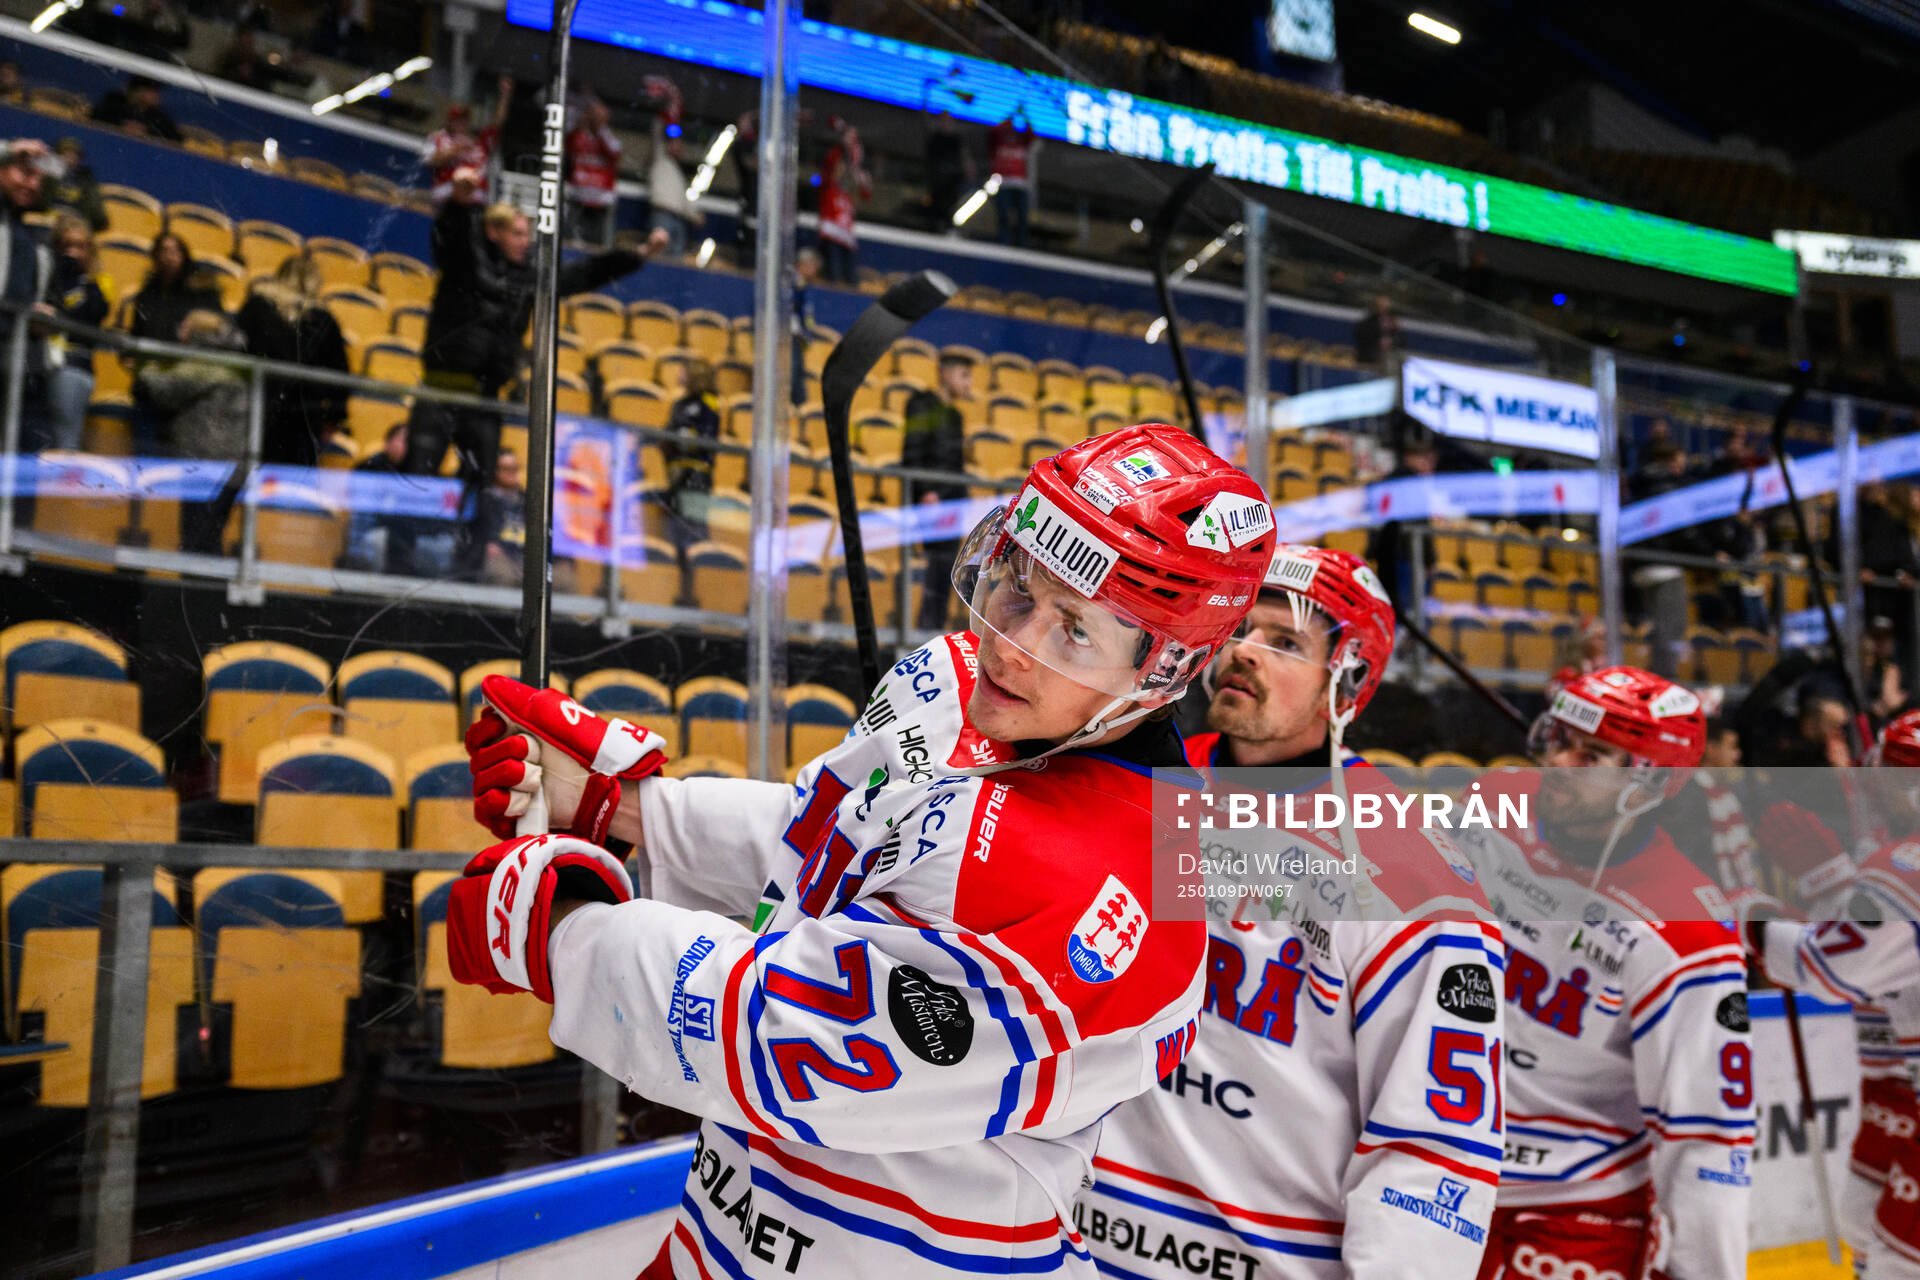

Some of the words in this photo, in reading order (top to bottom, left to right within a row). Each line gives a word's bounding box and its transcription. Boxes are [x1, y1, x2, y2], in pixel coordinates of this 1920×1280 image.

[1120, 460, 1148, 482] NHC
[1087, 492, 1101, 504] SPEL
[1030, 543, 1093, 593] FASTIGHETER
[1036, 515, 1109, 587] LILIUM
[667, 935, 716, 1026] SUNDSVALLS
[1090, 967, 1103, 981] IK
[684, 997, 714, 1039] ST
[763, 938, 903, 1103] 72
[898, 969, 946, 1060] Mästaren
[1380, 1187, 1453, 1229] SUNDSVALLS
